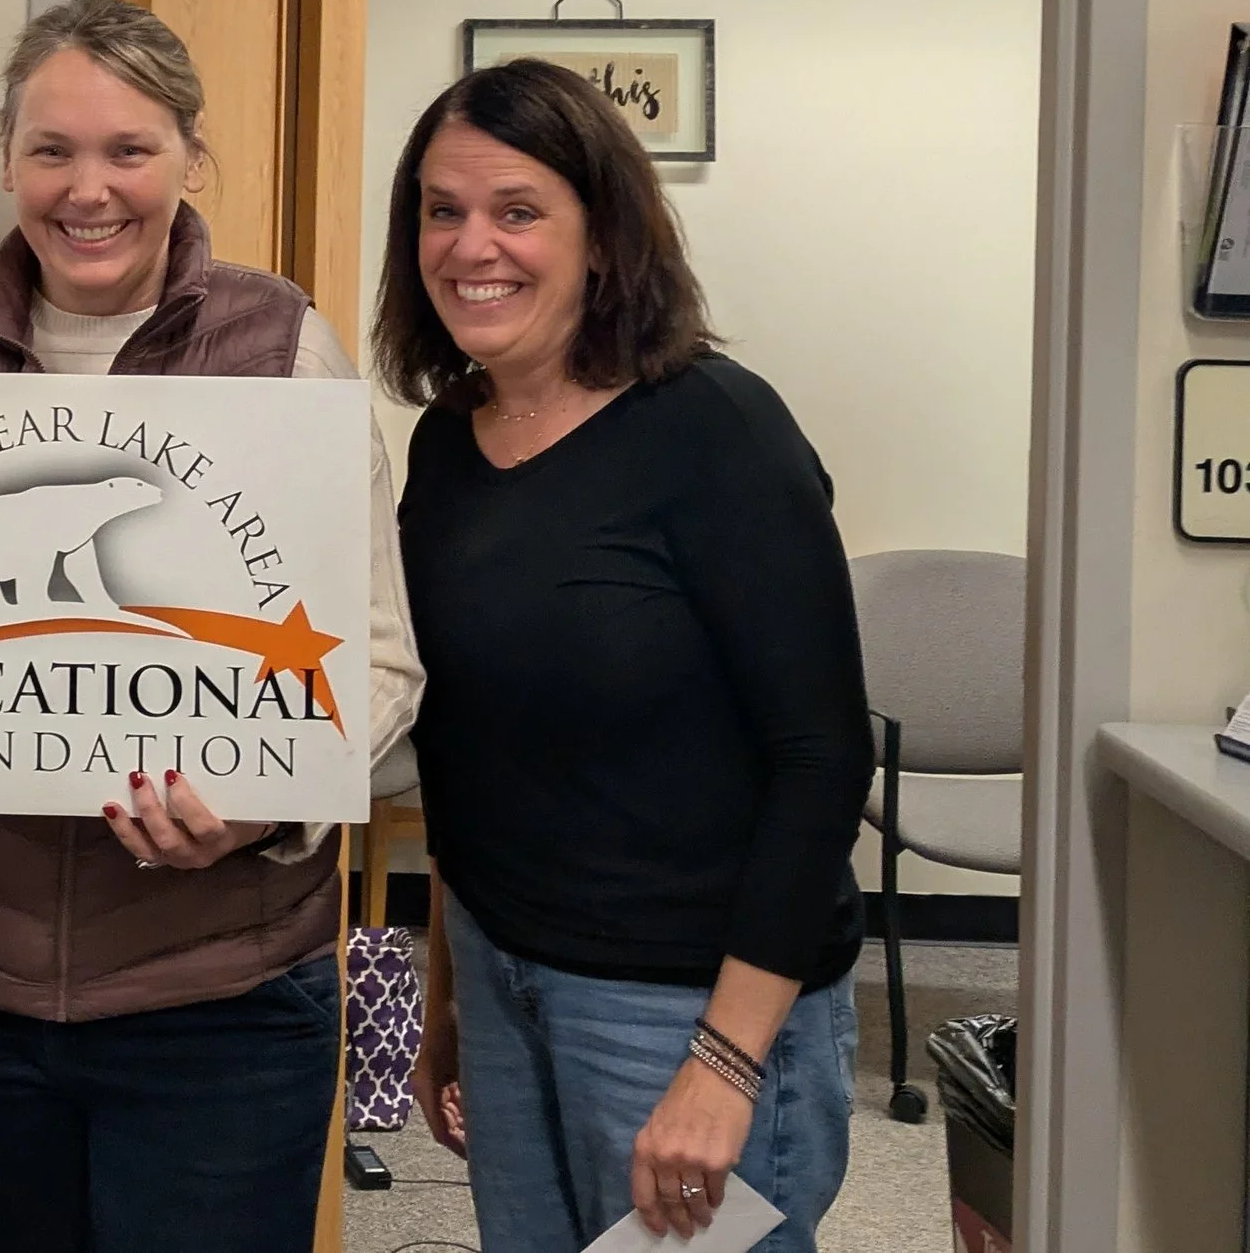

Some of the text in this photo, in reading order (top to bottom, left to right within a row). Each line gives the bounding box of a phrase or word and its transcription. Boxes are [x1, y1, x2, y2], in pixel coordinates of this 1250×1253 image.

[96, 410, 215, 492] LAKE
[205, 490, 292, 611] AREA
[1195, 458, 1250, 494] 10
